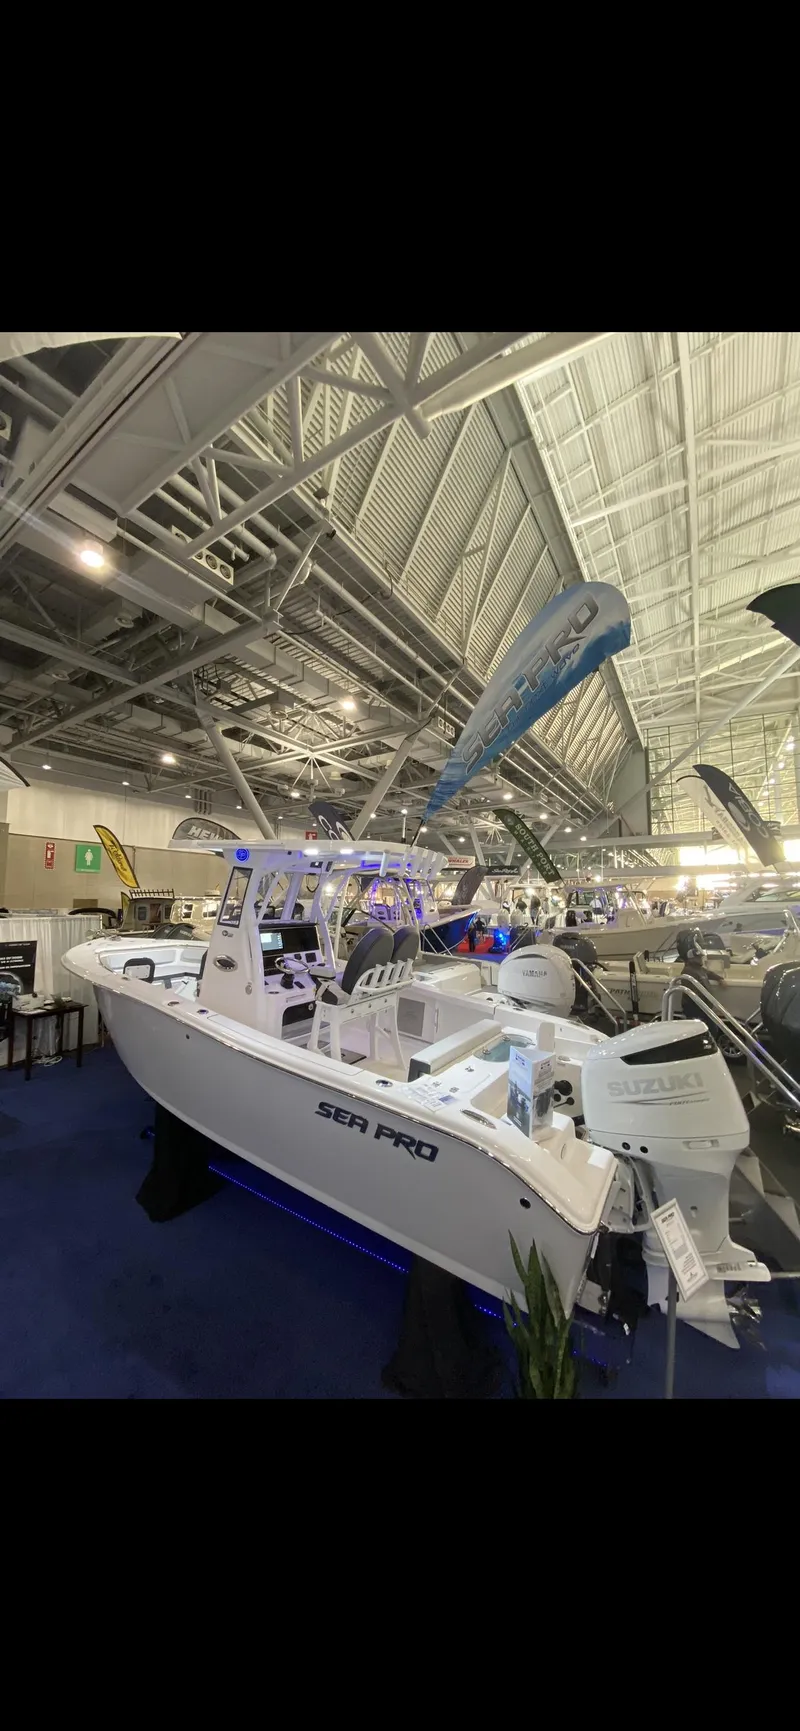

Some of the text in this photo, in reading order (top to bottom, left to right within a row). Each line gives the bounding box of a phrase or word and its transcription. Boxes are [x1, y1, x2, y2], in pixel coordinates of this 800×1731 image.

[462, 593, 600, 776] SEA PRO
[515, 823, 555, 876] SOUTH PORT
[607, 1072, 704, 1097] SUZUKI
[315, 1101, 439, 1162] SEA PRO
